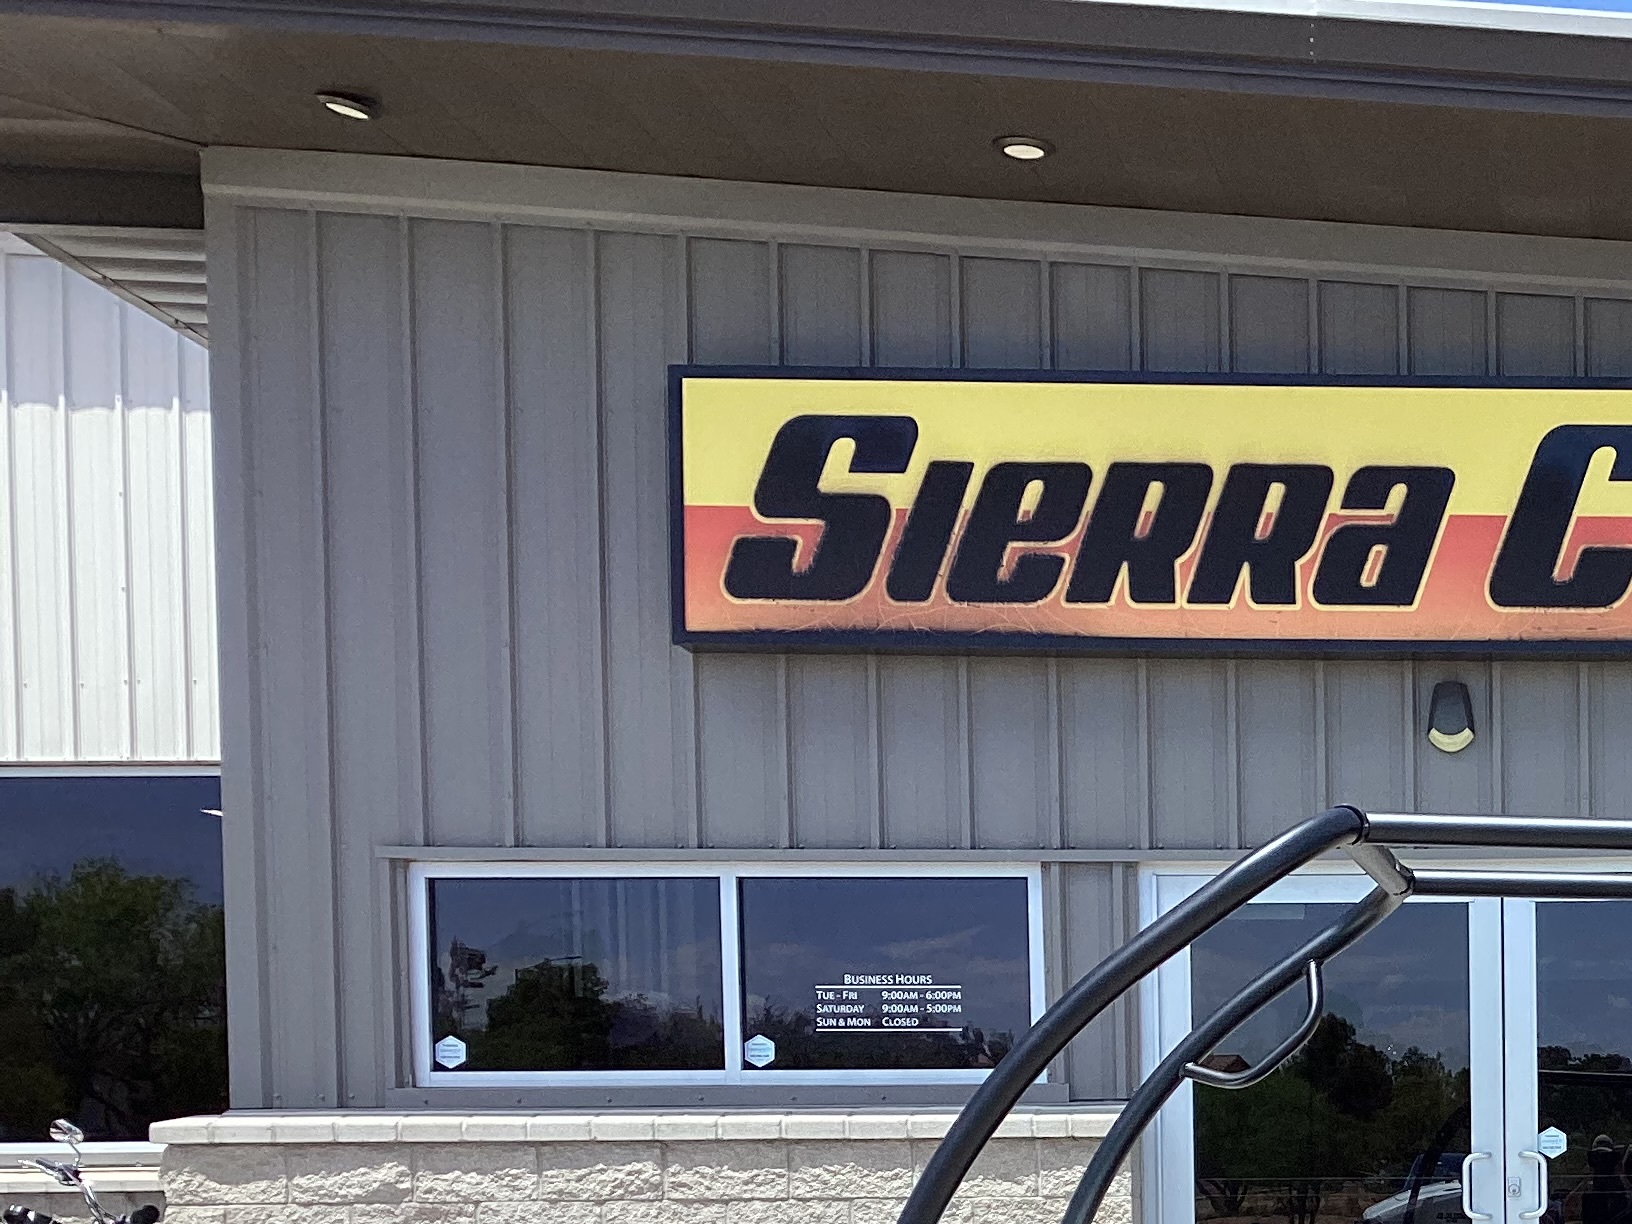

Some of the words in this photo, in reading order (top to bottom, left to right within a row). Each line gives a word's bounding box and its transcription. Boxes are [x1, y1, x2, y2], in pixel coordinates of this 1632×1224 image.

[843, 974, 894, 985] BUSINESS
[895, 974, 933, 985] HOURS
[816, 990, 835, 1000] TUE
[842, 990, 858, 1000] FRI
[881, 990, 919, 1000] 9:00AM
[925, 990, 962, 1000] 6:00PM
[816, 1003, 865, 1014] SATURDAY
[881, 1003, 919, 1014] 9:00AM
[926, 1003, 962, 1013] 5:00PM
[816, 1016, 837, 1027] SUN
[838, 1017, 846, 1027] &
[846, 1017, 871, 1027] MON
[881, 1016, 919, 1027] CLOSED
